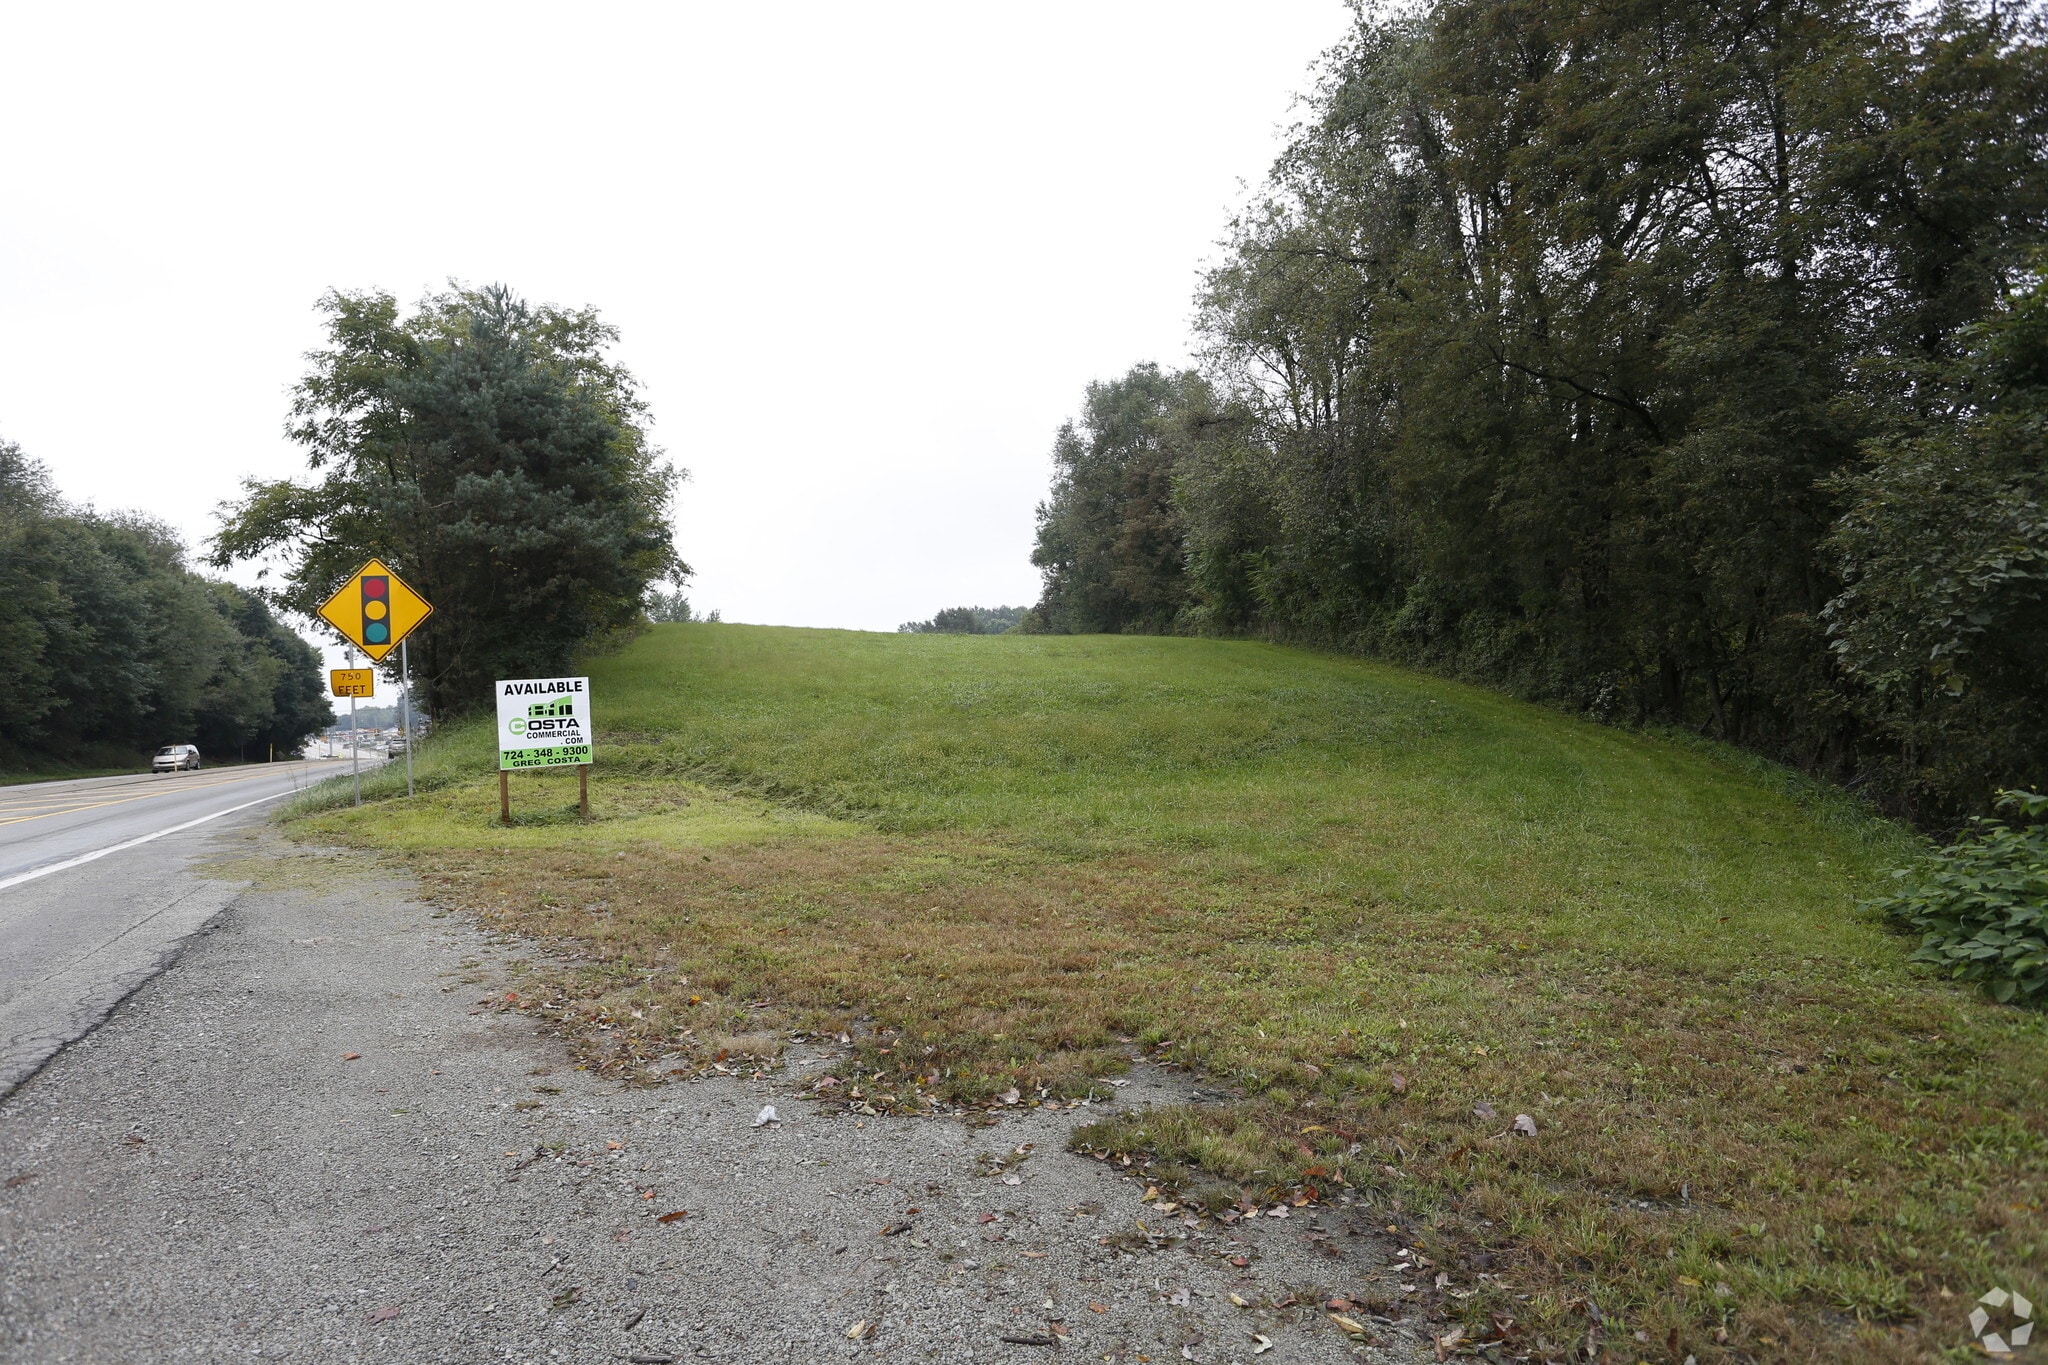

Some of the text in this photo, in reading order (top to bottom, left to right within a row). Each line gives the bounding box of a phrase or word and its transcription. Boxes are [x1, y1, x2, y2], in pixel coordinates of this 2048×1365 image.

[340, 672, 361, 680] 750
[338, 685, 366, 694] FEET
[504, 681, 582, 696] AVAILABLE
[526, 730, 580, 739] COMMERCIAL
[547, 756, 580, 764] COSTA
